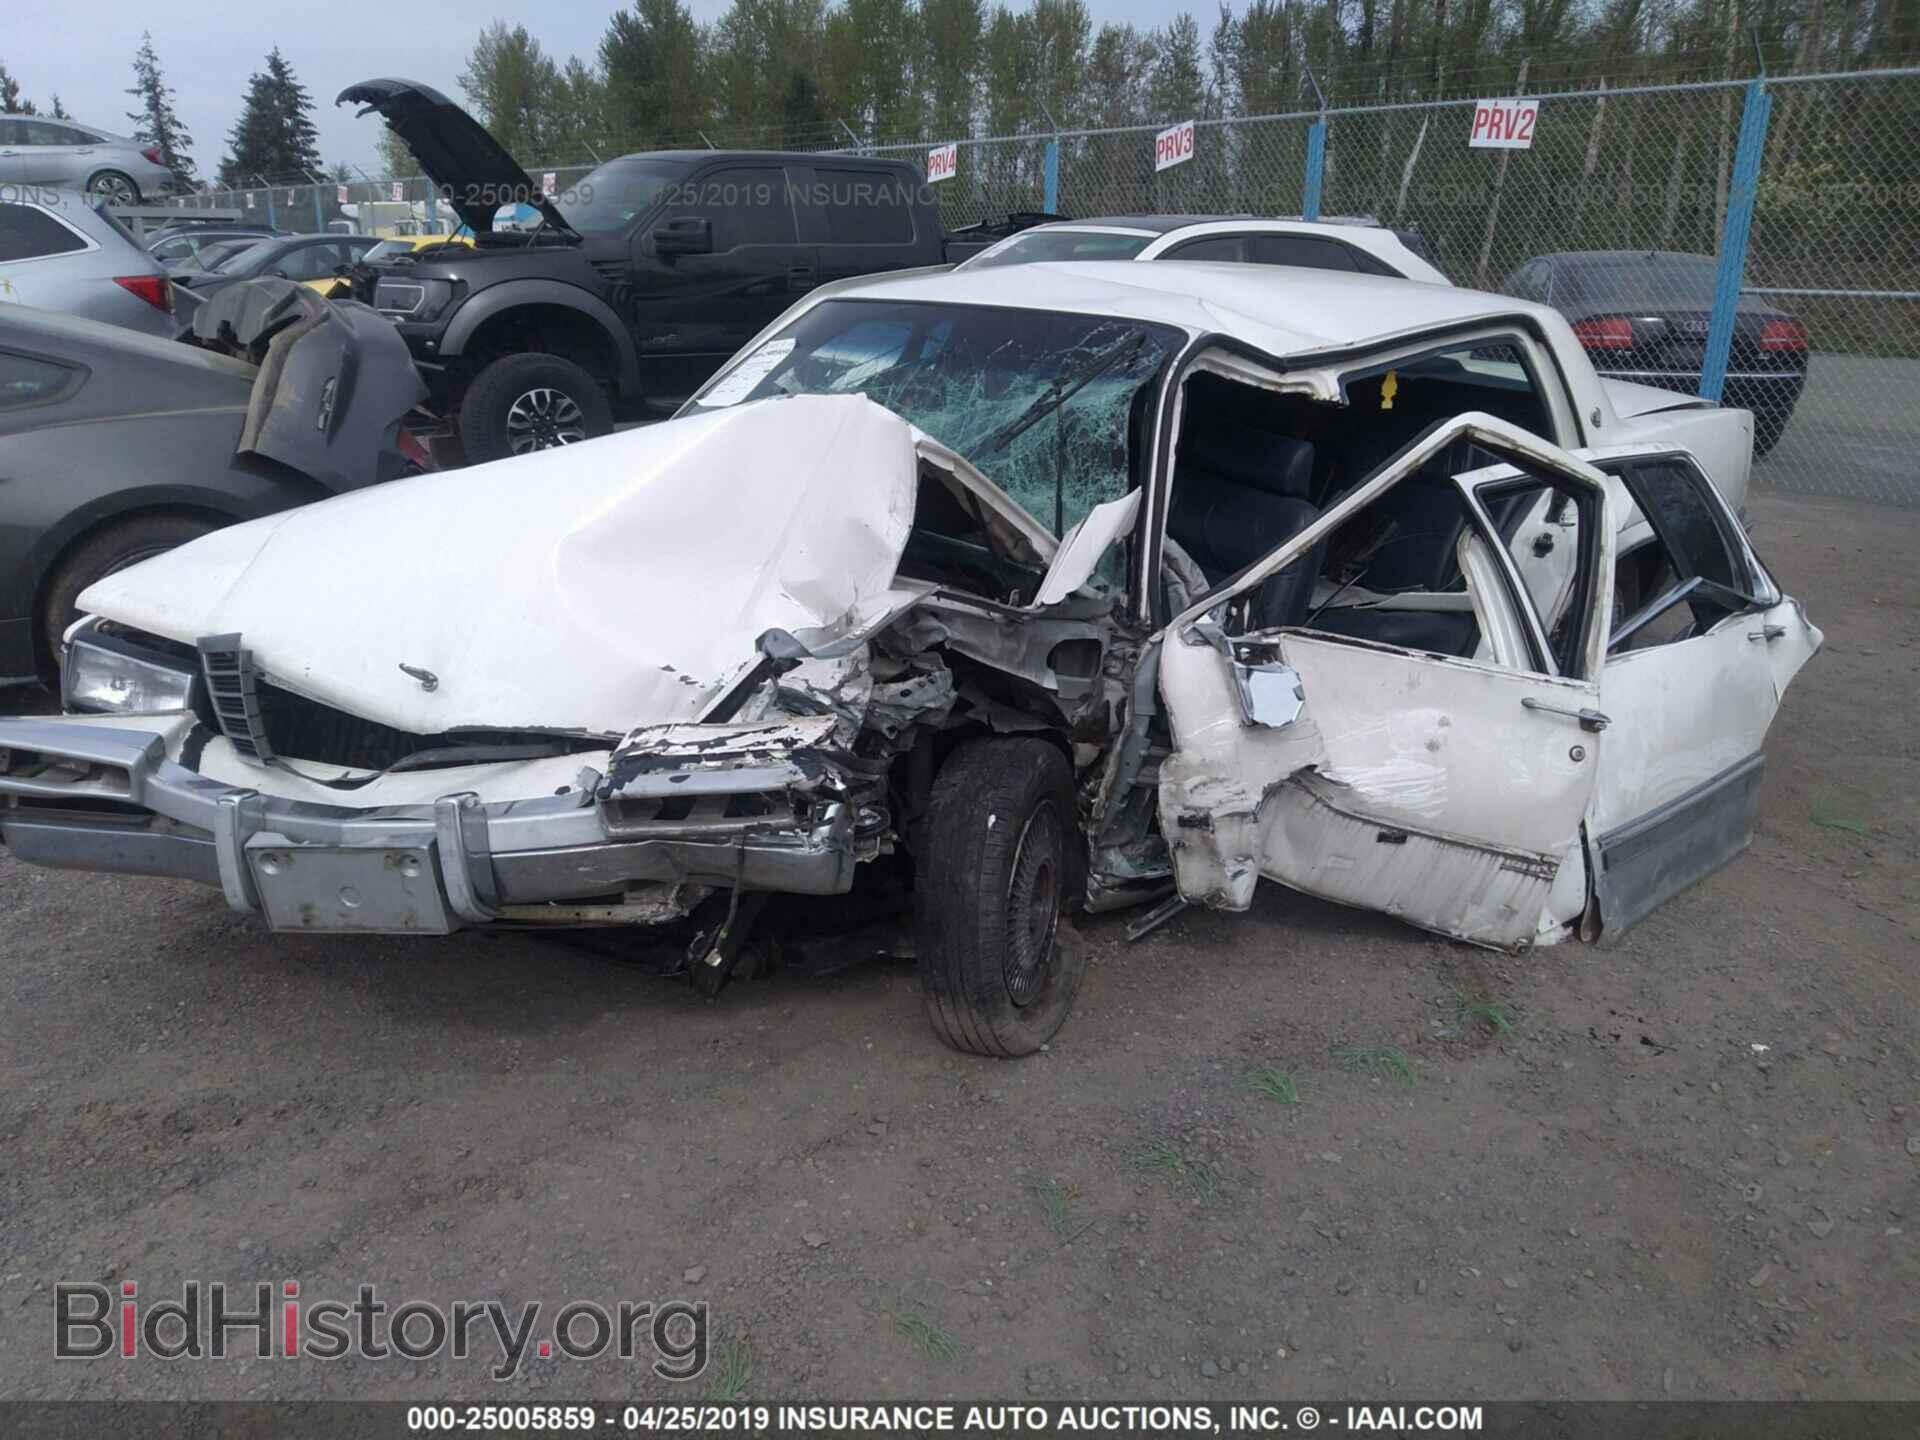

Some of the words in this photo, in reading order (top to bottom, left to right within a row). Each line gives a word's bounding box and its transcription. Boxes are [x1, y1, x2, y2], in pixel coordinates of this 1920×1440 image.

[1472, 108, 1536, 140] PRV2
[1157, 127, 1193, 164] PRV3
[928, 150, 956, 176] PRV4
